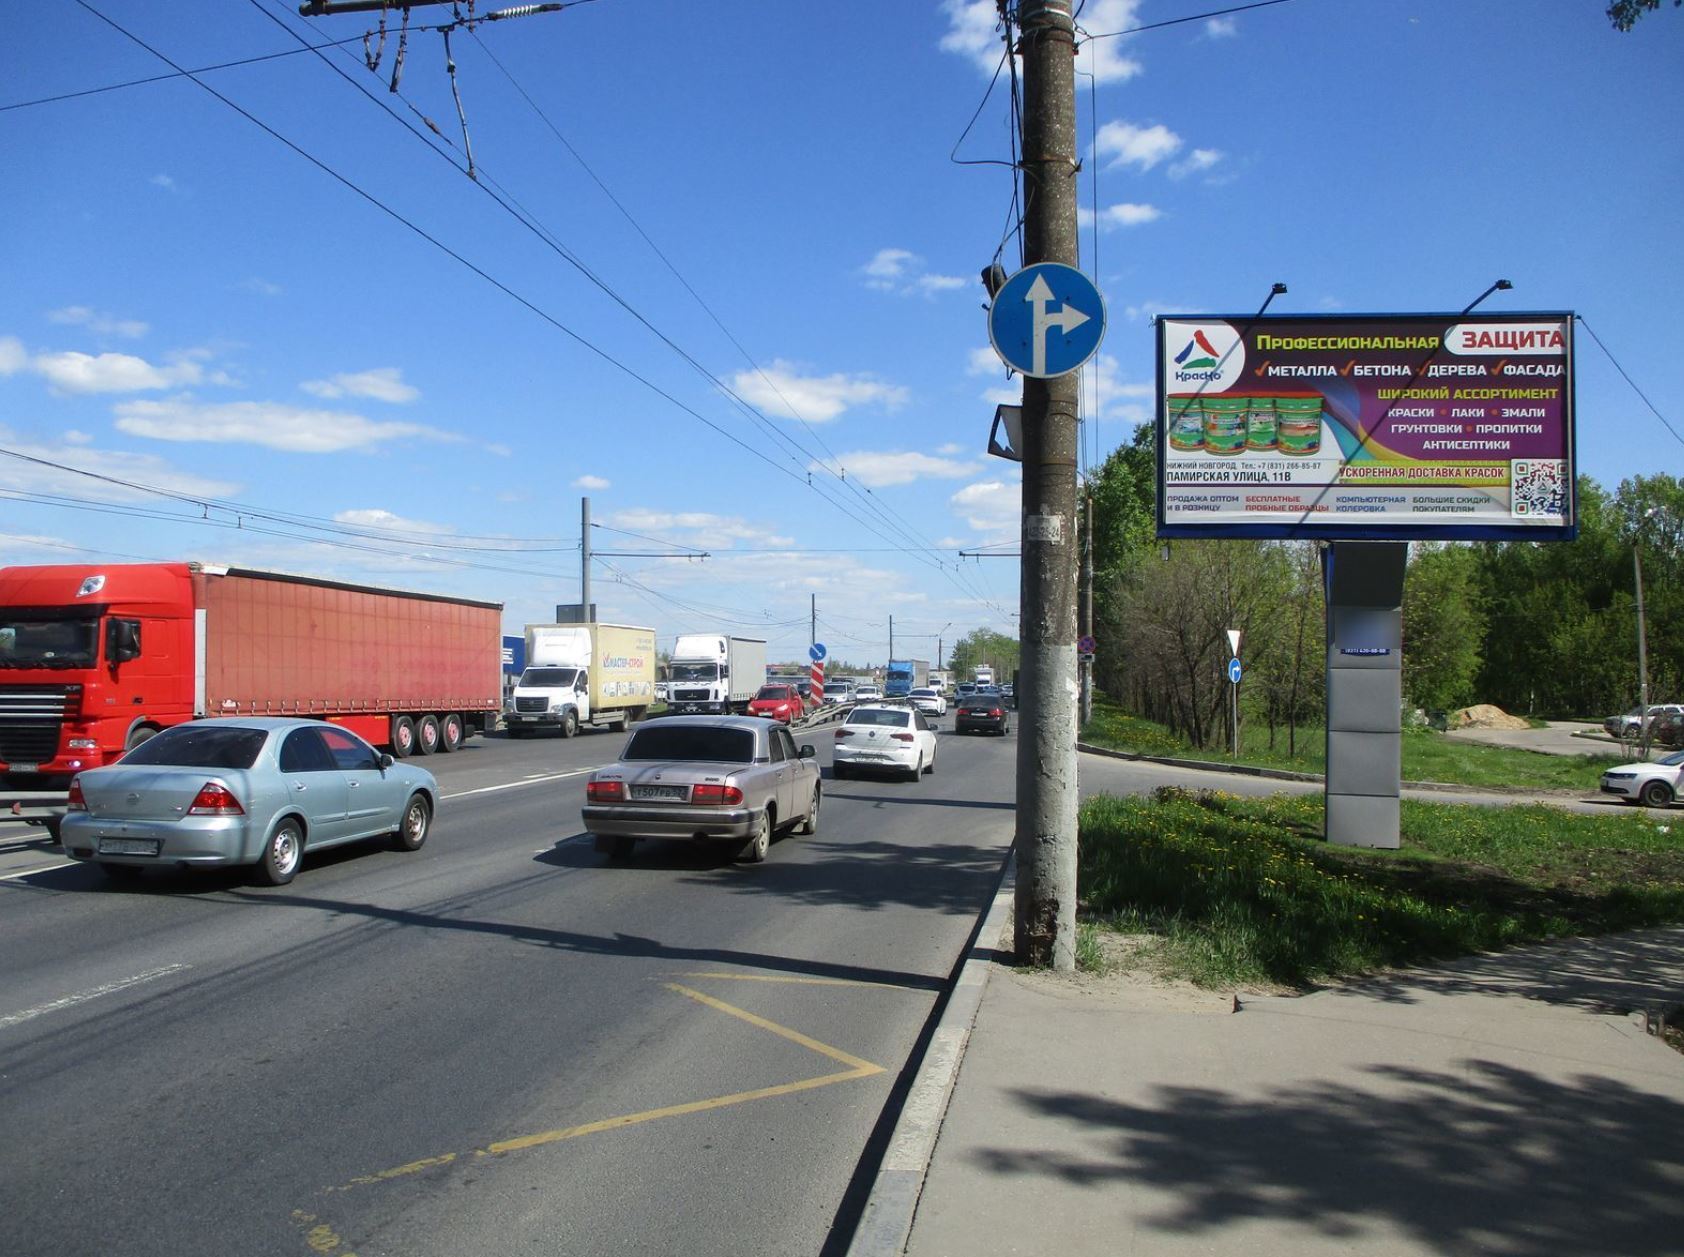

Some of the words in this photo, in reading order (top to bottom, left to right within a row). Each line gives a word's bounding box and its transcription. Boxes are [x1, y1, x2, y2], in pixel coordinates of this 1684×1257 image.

[1462, 331, 1566, 350] ЗАЩИТА
[1268, 365, 1337, 377] МЕТАЛЛА
[1354, 365, 1412, 377] БЕТОНА
[1427, 365, 1487, 378] ДЕРЕВА
[1503, 364, 1566, 377] ФАСАДА
[1377, 386, 1449, 399] ШИРОКИЙ
[1453, 388, 1558, 400] АССОРТИМЕНТ
[1388, 408, 1434, 417] КРАСКИ
[1451, 408, 1484, 417] ЛАКИ
[1501, 408, 1546, 417] ЭМАЛИ
[1391, 424, 1462, 433] ГРУНТОВКИ
[1476, 424, 1542, 433] ПРОПИТКИ
[1423, 440, 1510, 450] АНТИСЕПТИКИ
[1167, 462, 1197, 470] НИЖНИЙ
[1267, 462, 1285, 471] (831)
[1167, 471, 1229, 482] ПАМИРСКАЯ
[1339, 467, 1405, 478] УСКОРЕННАЯ
[1408, 467, 1462, 479] ДОСТАВКА
[1464, 467, 1504, 478] КРАСОК
[1167, 495, 1208, 503] ПРОДАЖА
[1412, 496, 1455, 504] БОЛЬШИЕ
[1456, 497, 1490, 505] СКИДКИ
[1182, 504, 1221, 512] РОЗНИЦУ
[1245, 504, 1286, 512] ПРОБНЫЕ
[1288, 504, 1329, 512] ОБРАЗЦЫ
[1336, 505, 1386, 513] КОЛЕРОВКА
[1412, 505, 1475, 513] ПОКУПАТЕЛЯМ
